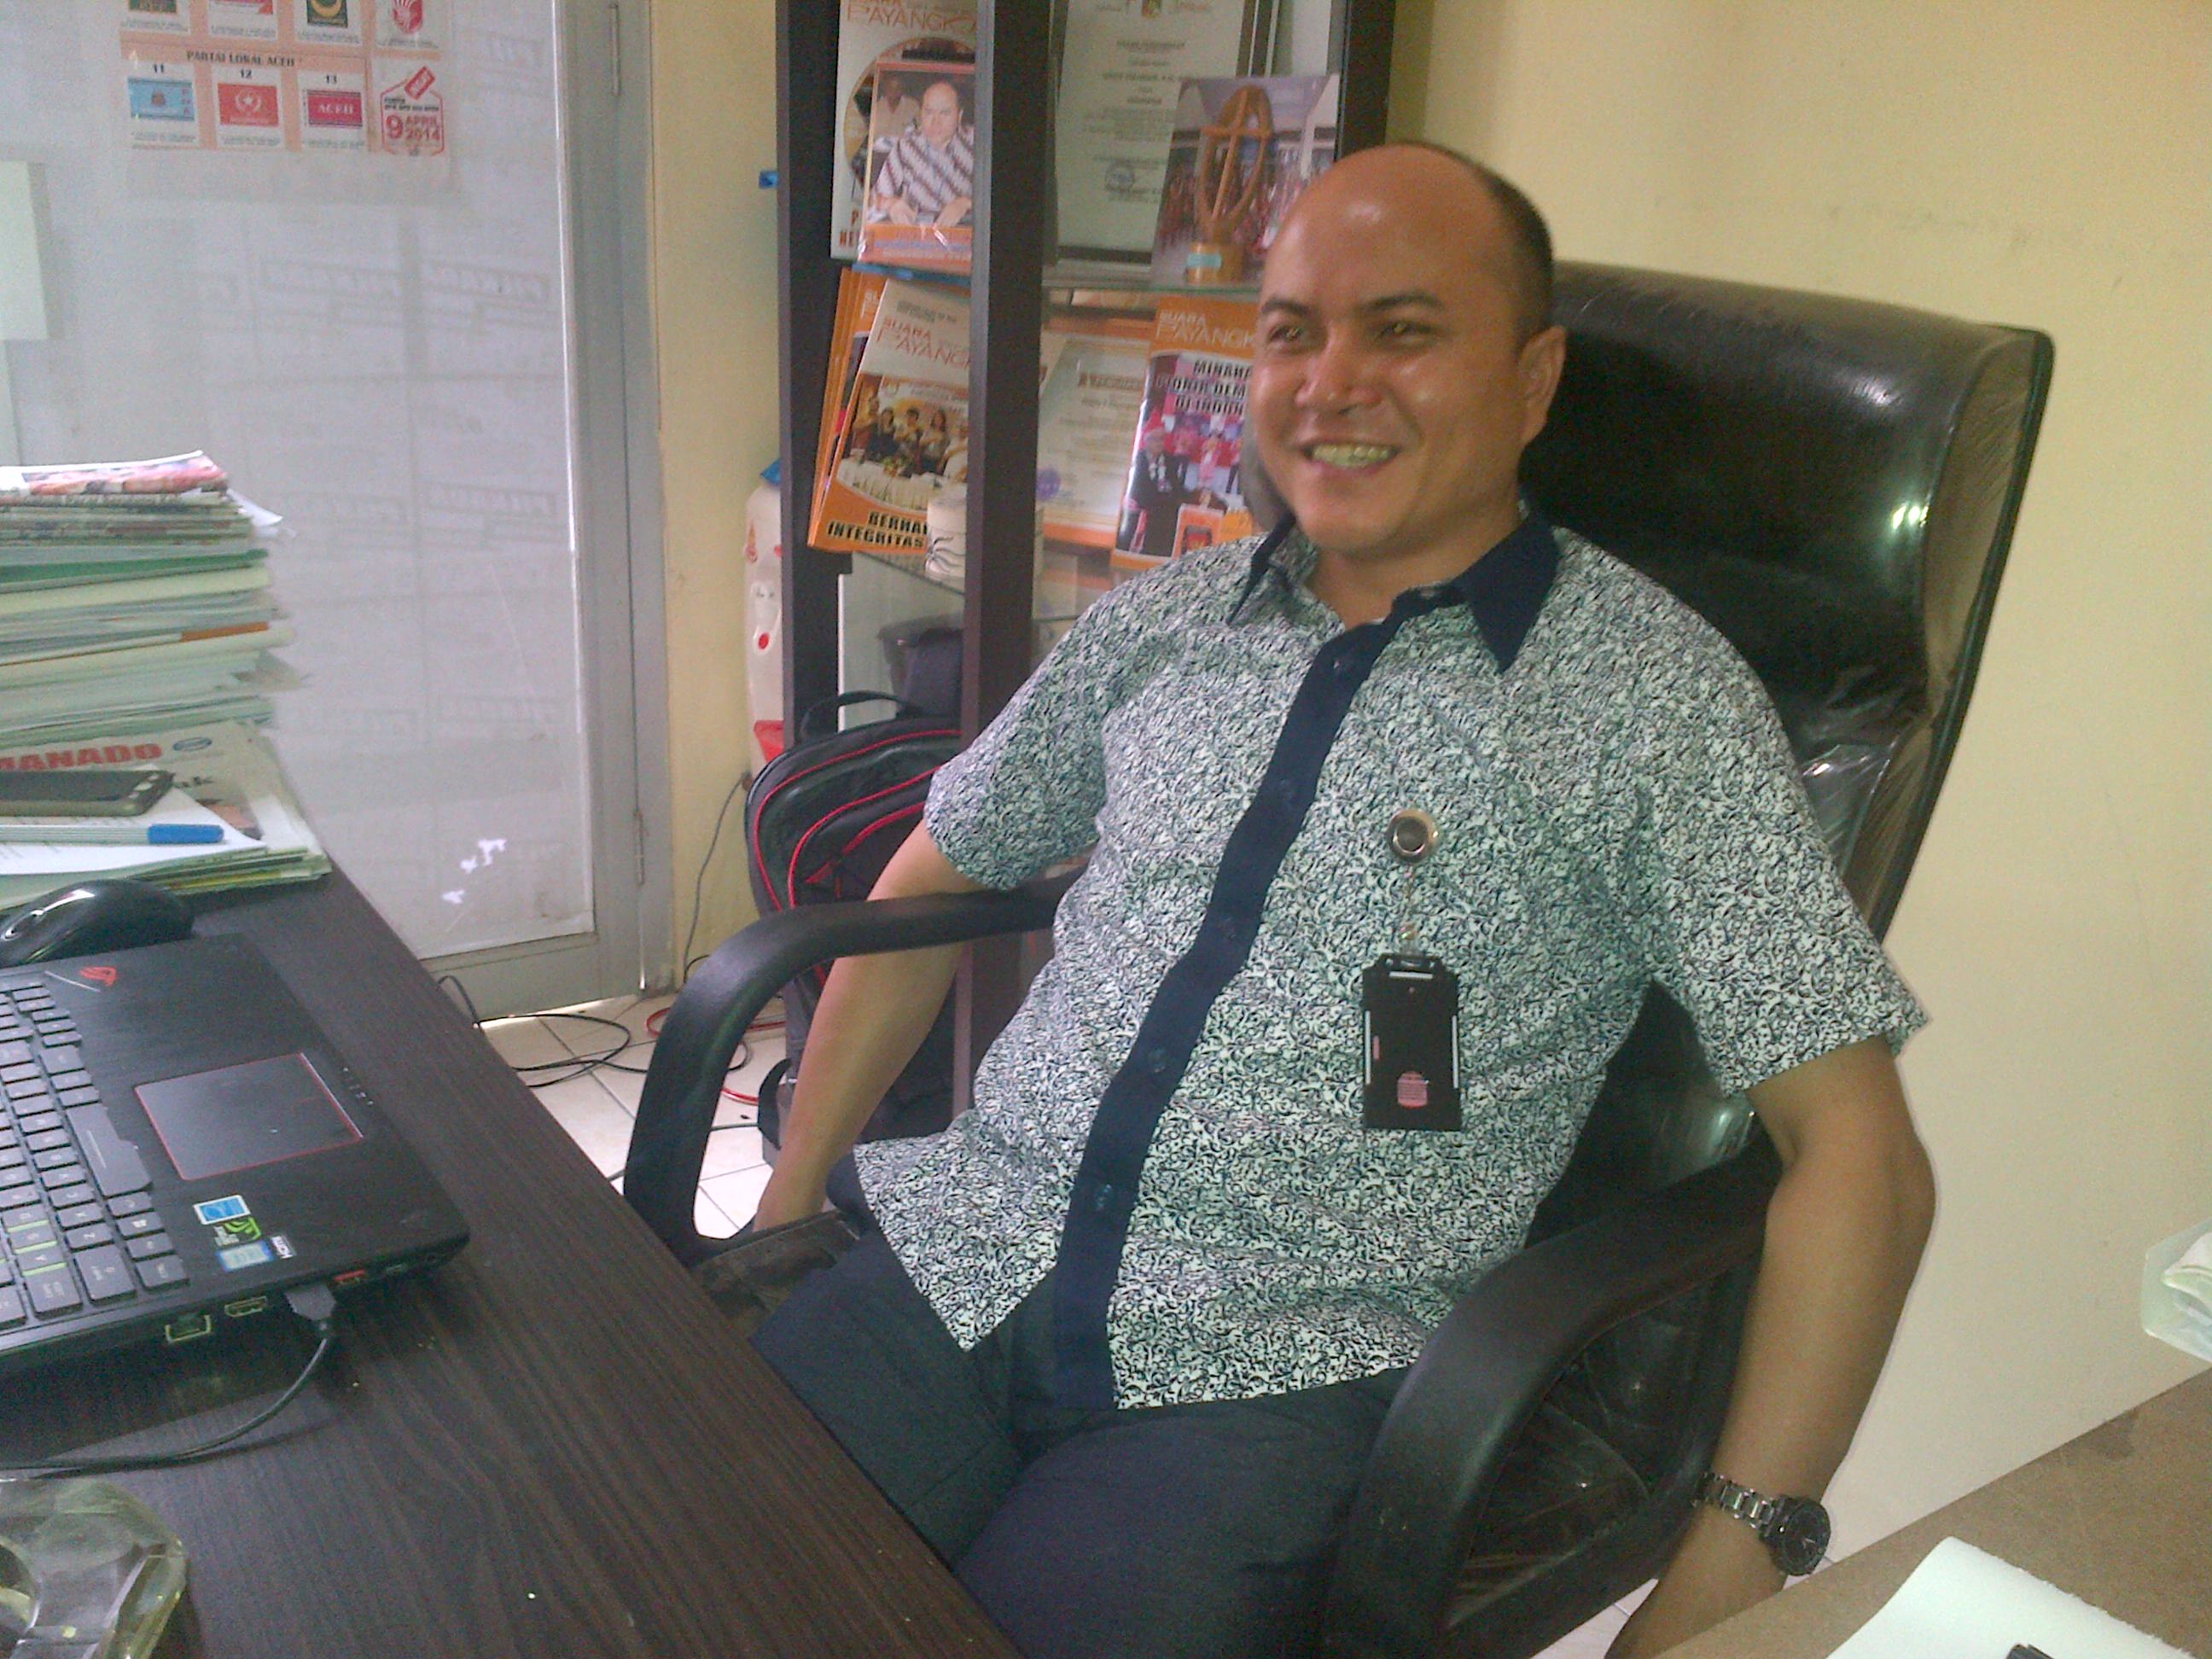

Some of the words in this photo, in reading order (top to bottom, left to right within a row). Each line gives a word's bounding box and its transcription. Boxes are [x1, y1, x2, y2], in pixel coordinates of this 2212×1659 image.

[186, 50, 226, 63] PARTAI
[229, 54, 262, 66] LOKAL
[153, 64, 165, 73] 11
[240, 70, 252, 79] 12
[326, 74, 337, 84] 13
[386, 114, 404, 140] 9
[405, 126, 441, 143] 2014
[828, 521, 925, 548] INTEGRITAS
